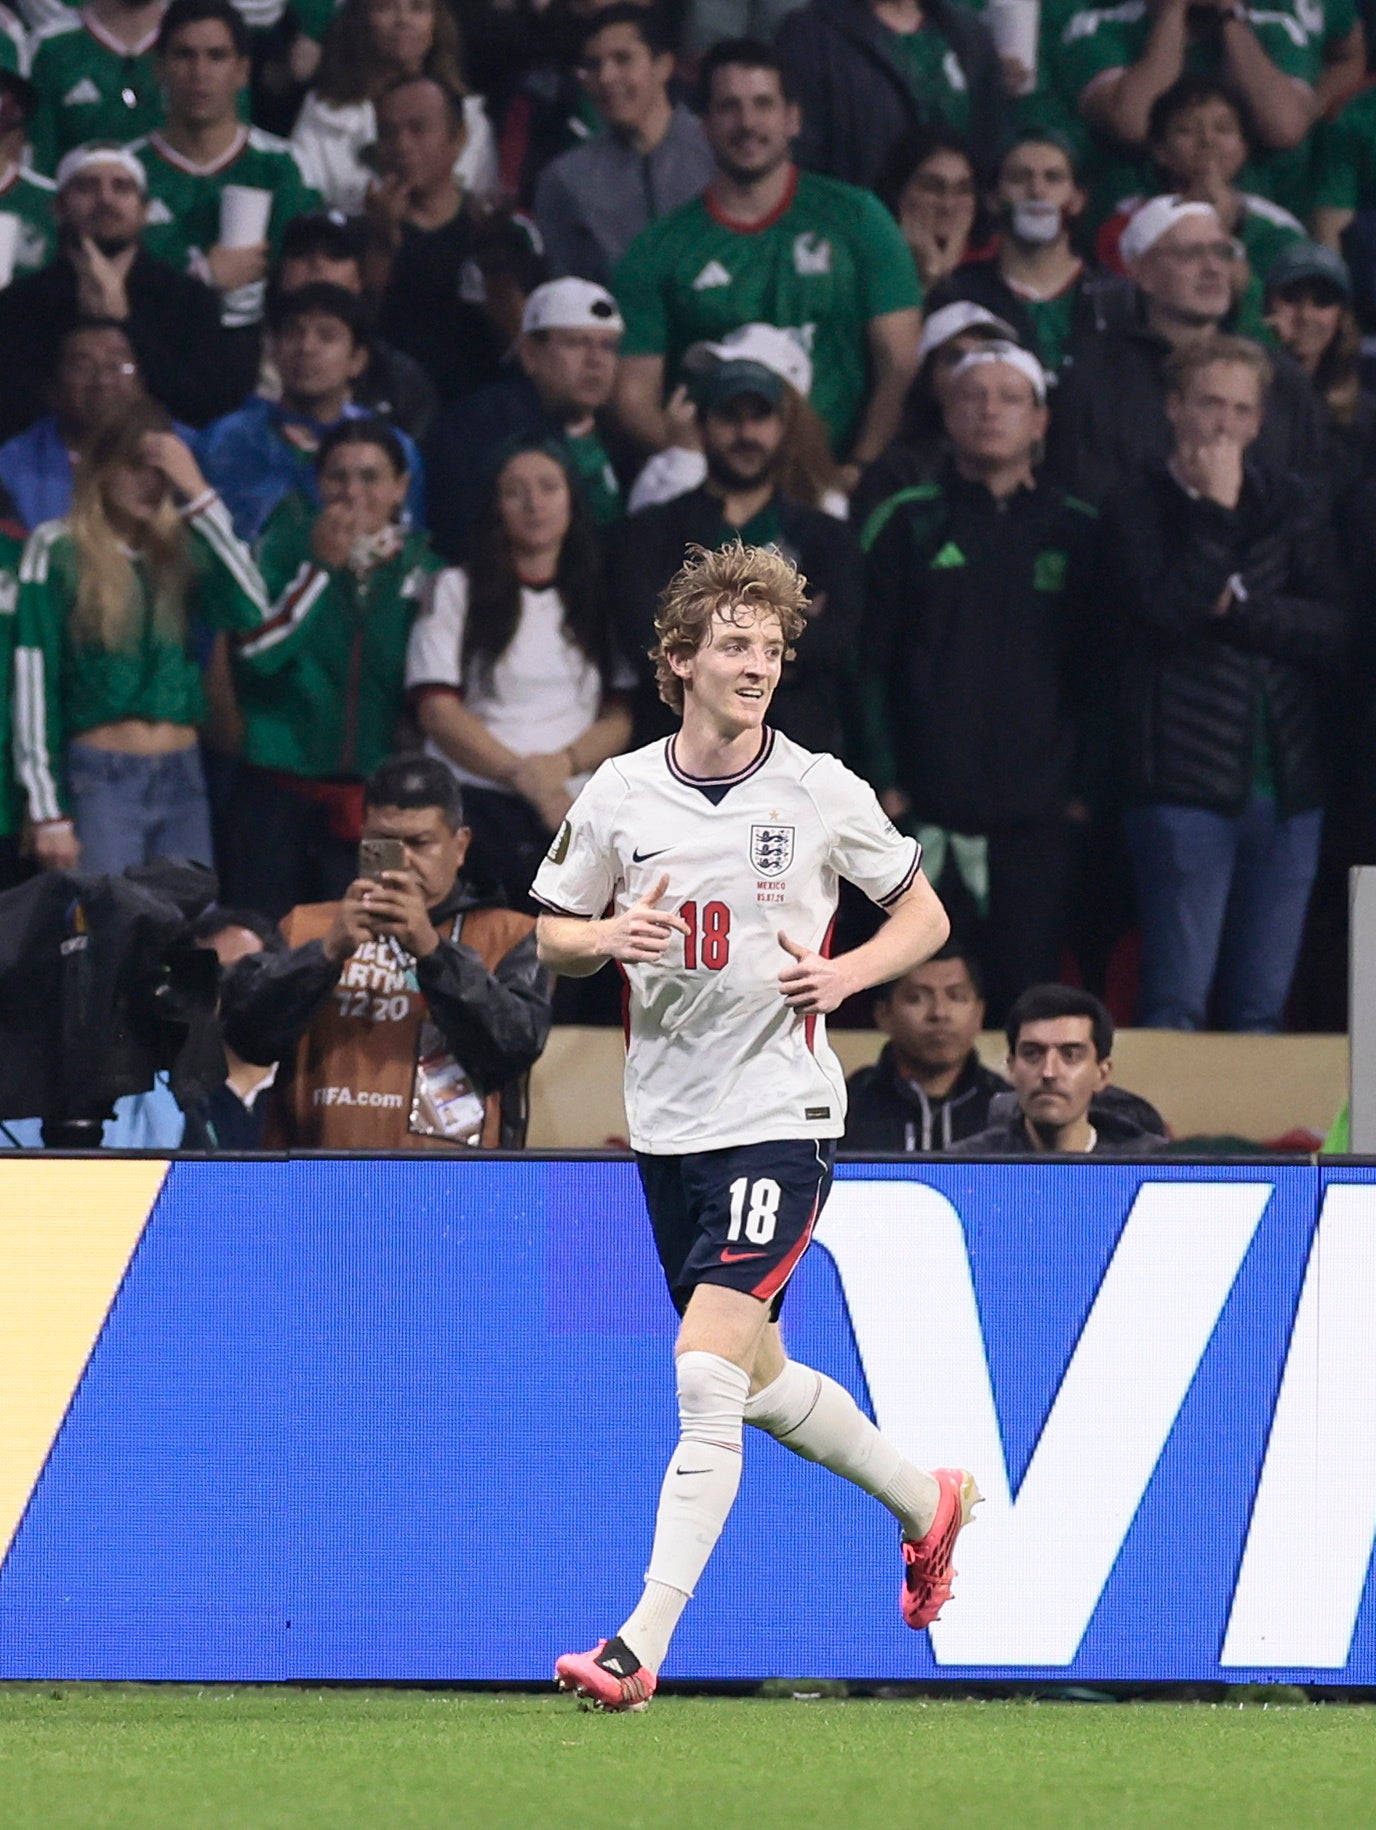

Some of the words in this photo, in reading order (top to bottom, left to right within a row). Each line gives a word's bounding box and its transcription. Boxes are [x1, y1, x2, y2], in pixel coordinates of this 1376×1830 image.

[757, 881, 786, 890] MEXICO
[679, 900, 730, 970] 18
[313, 1086, 403, 1108] FIFA.com
[727, 1177, 781, 1245] 18
